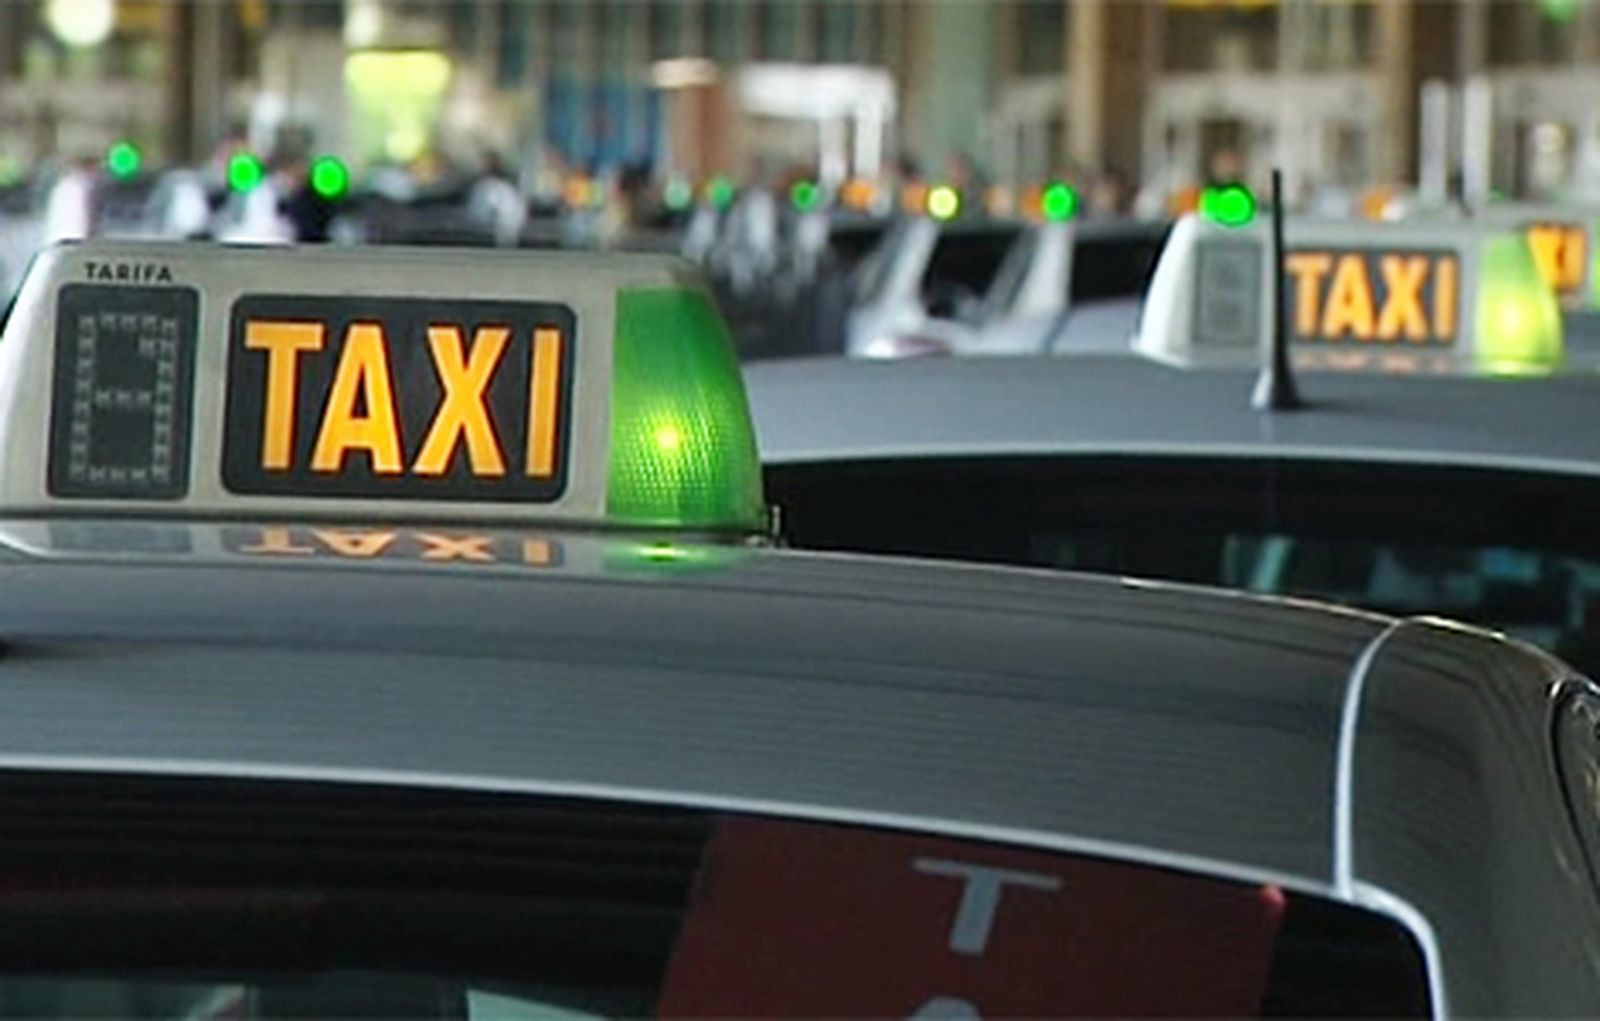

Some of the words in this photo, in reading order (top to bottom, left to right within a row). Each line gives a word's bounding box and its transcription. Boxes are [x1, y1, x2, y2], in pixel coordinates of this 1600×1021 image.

[84, 262, 174, 282] TARIFA
[1286, 252, 1459, 342] TAXI
[244, 321, 561, 477] TAXI
